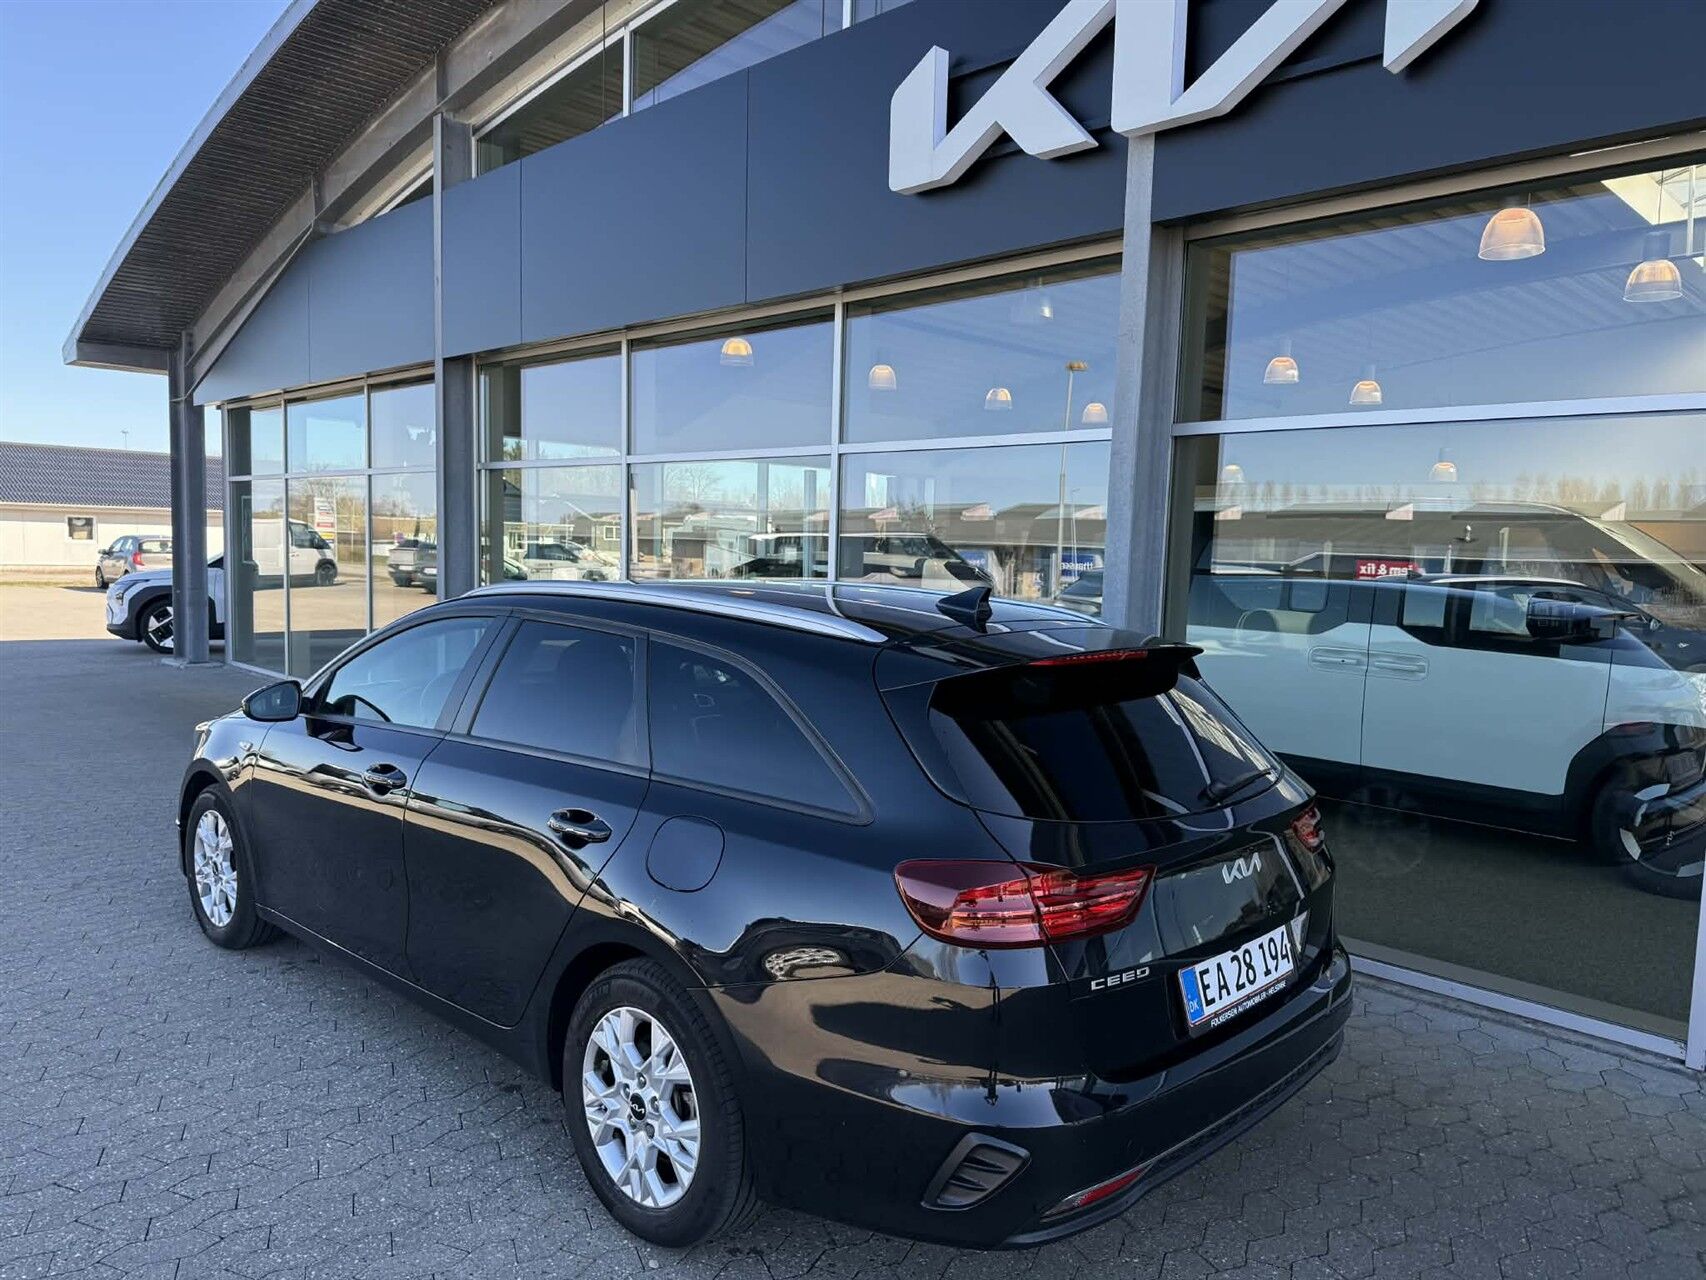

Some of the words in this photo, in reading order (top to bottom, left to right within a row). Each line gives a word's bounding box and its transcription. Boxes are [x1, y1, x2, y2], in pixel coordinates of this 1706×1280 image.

[1222, 852, 1262, 884] KIA
[1091, 966, 1150, 990] CEED
[1199, 962, 1232, 1008] EA
[1230, 948, 1257, 993] 28
[1258, 930, 1291, 978] 194
[1189, 1000, 1200, 1013] DK
